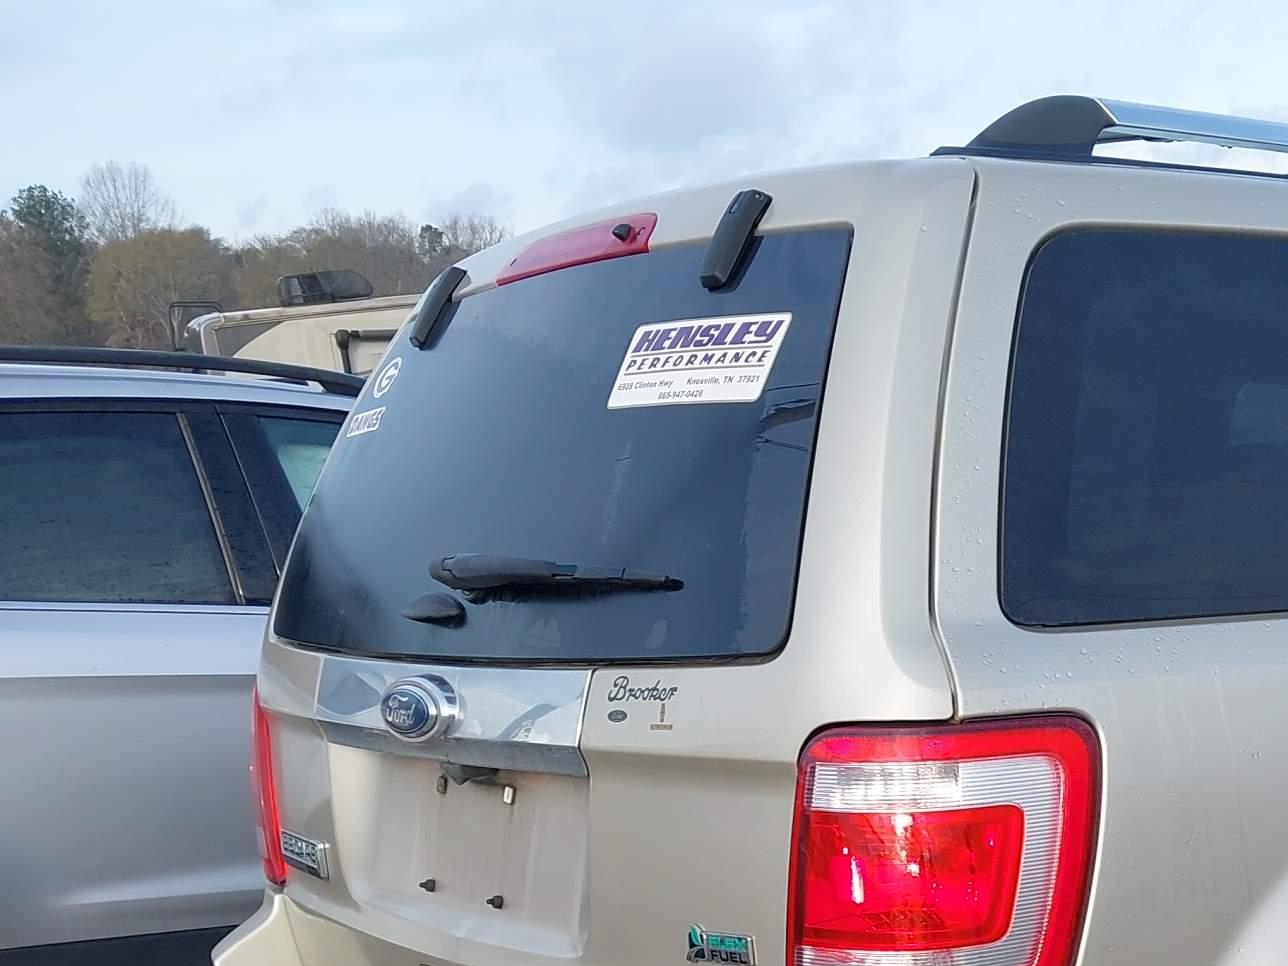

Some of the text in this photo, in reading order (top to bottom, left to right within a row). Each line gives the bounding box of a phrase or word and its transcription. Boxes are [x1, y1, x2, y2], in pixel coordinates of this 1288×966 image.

[631, 320, 785, 353] HENSLEY
[625, 350, 771, 372] PERFORMANCE
[634, 381, 658, 390] Clinton
[658, 379, 674, 389] Hwy
[686, 376, 720, 385] Knoxville,
[723, 375, 734, 384] TN
[386, 694, 416, 726] Ford
[710, 950, 748, 965] FUEL
